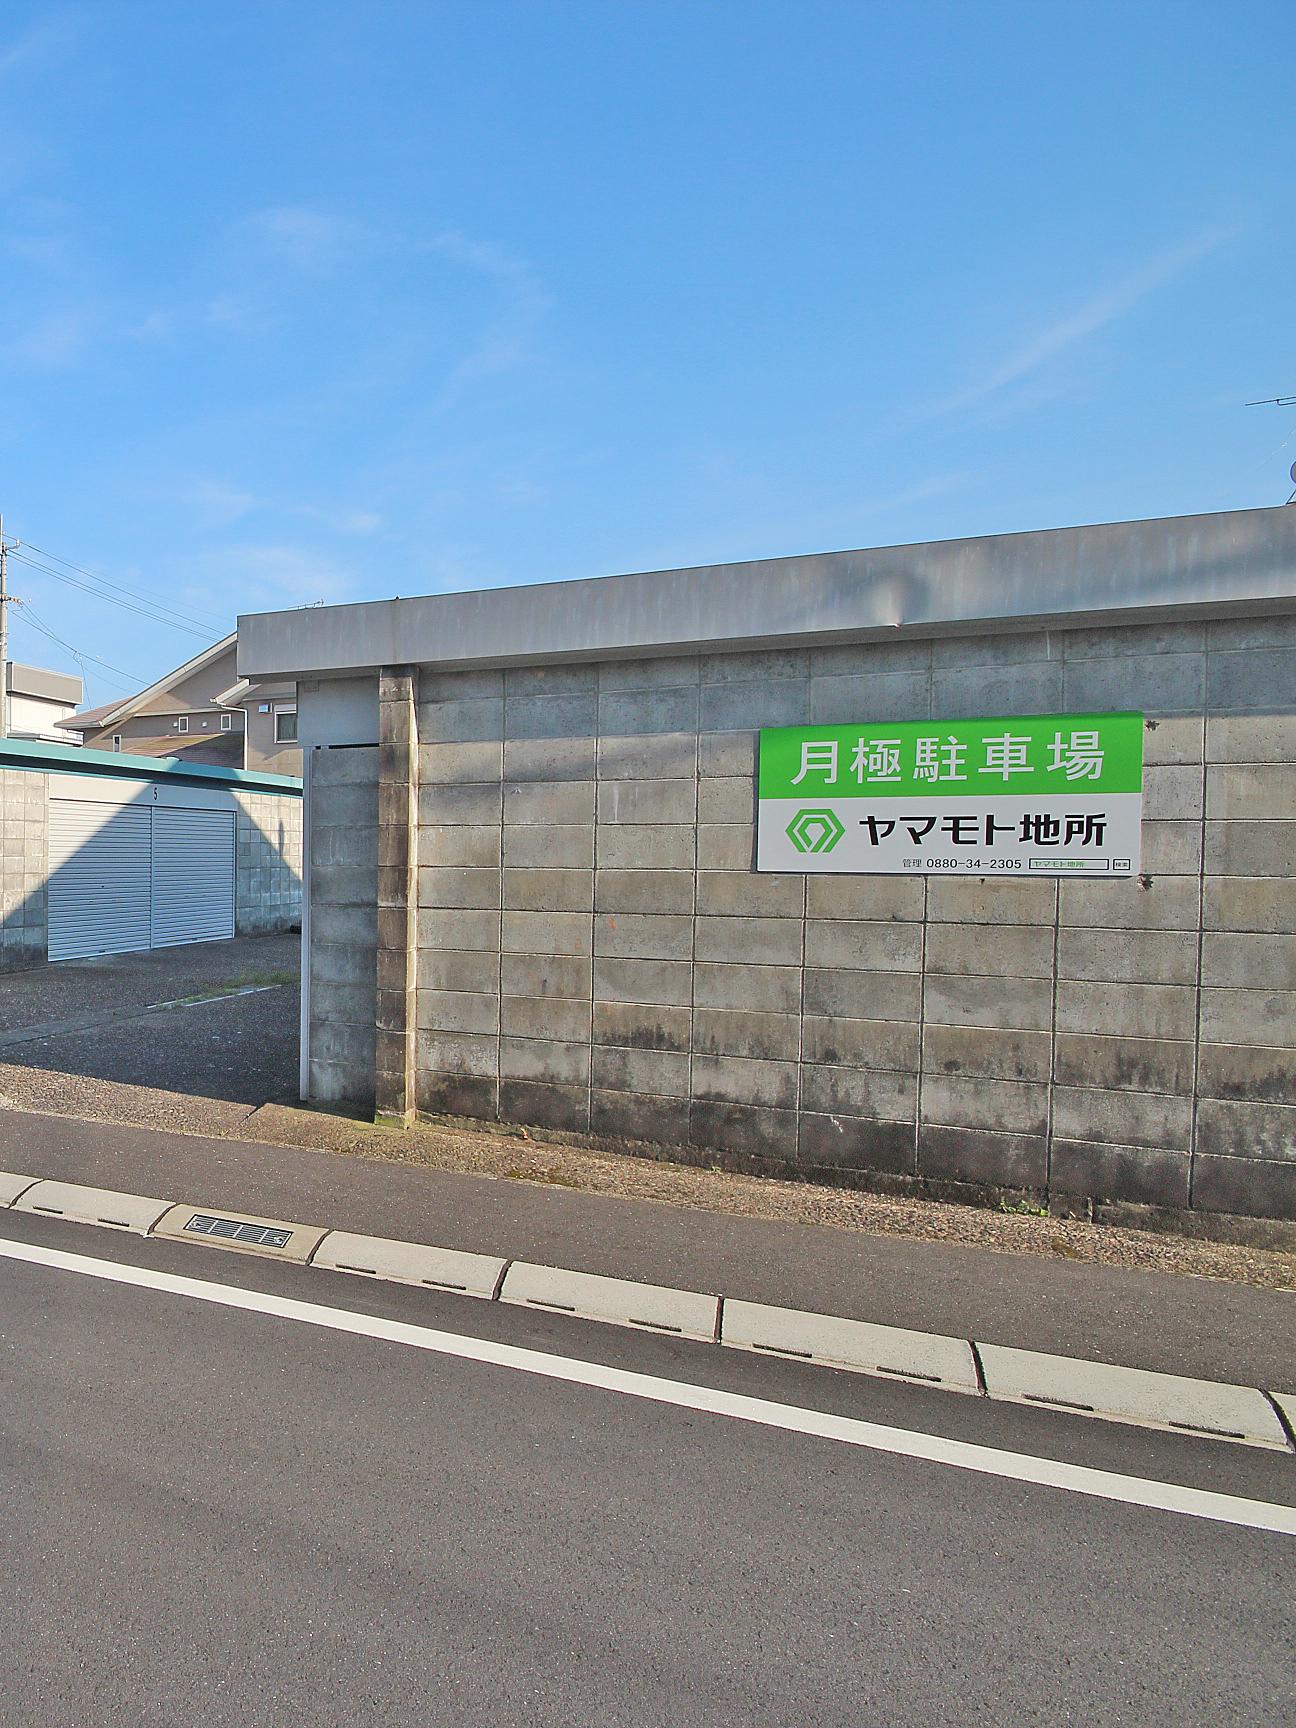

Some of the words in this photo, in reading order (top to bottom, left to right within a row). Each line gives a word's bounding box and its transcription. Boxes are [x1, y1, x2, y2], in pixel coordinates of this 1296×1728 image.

[790, 730, 1105, 785] 月極駐車場
[858, 812, 1108, 847] ヤマモト地所
[902, 858, 922, 868] 管理
[926, 858, 1022, 869] 0880-34-2305
